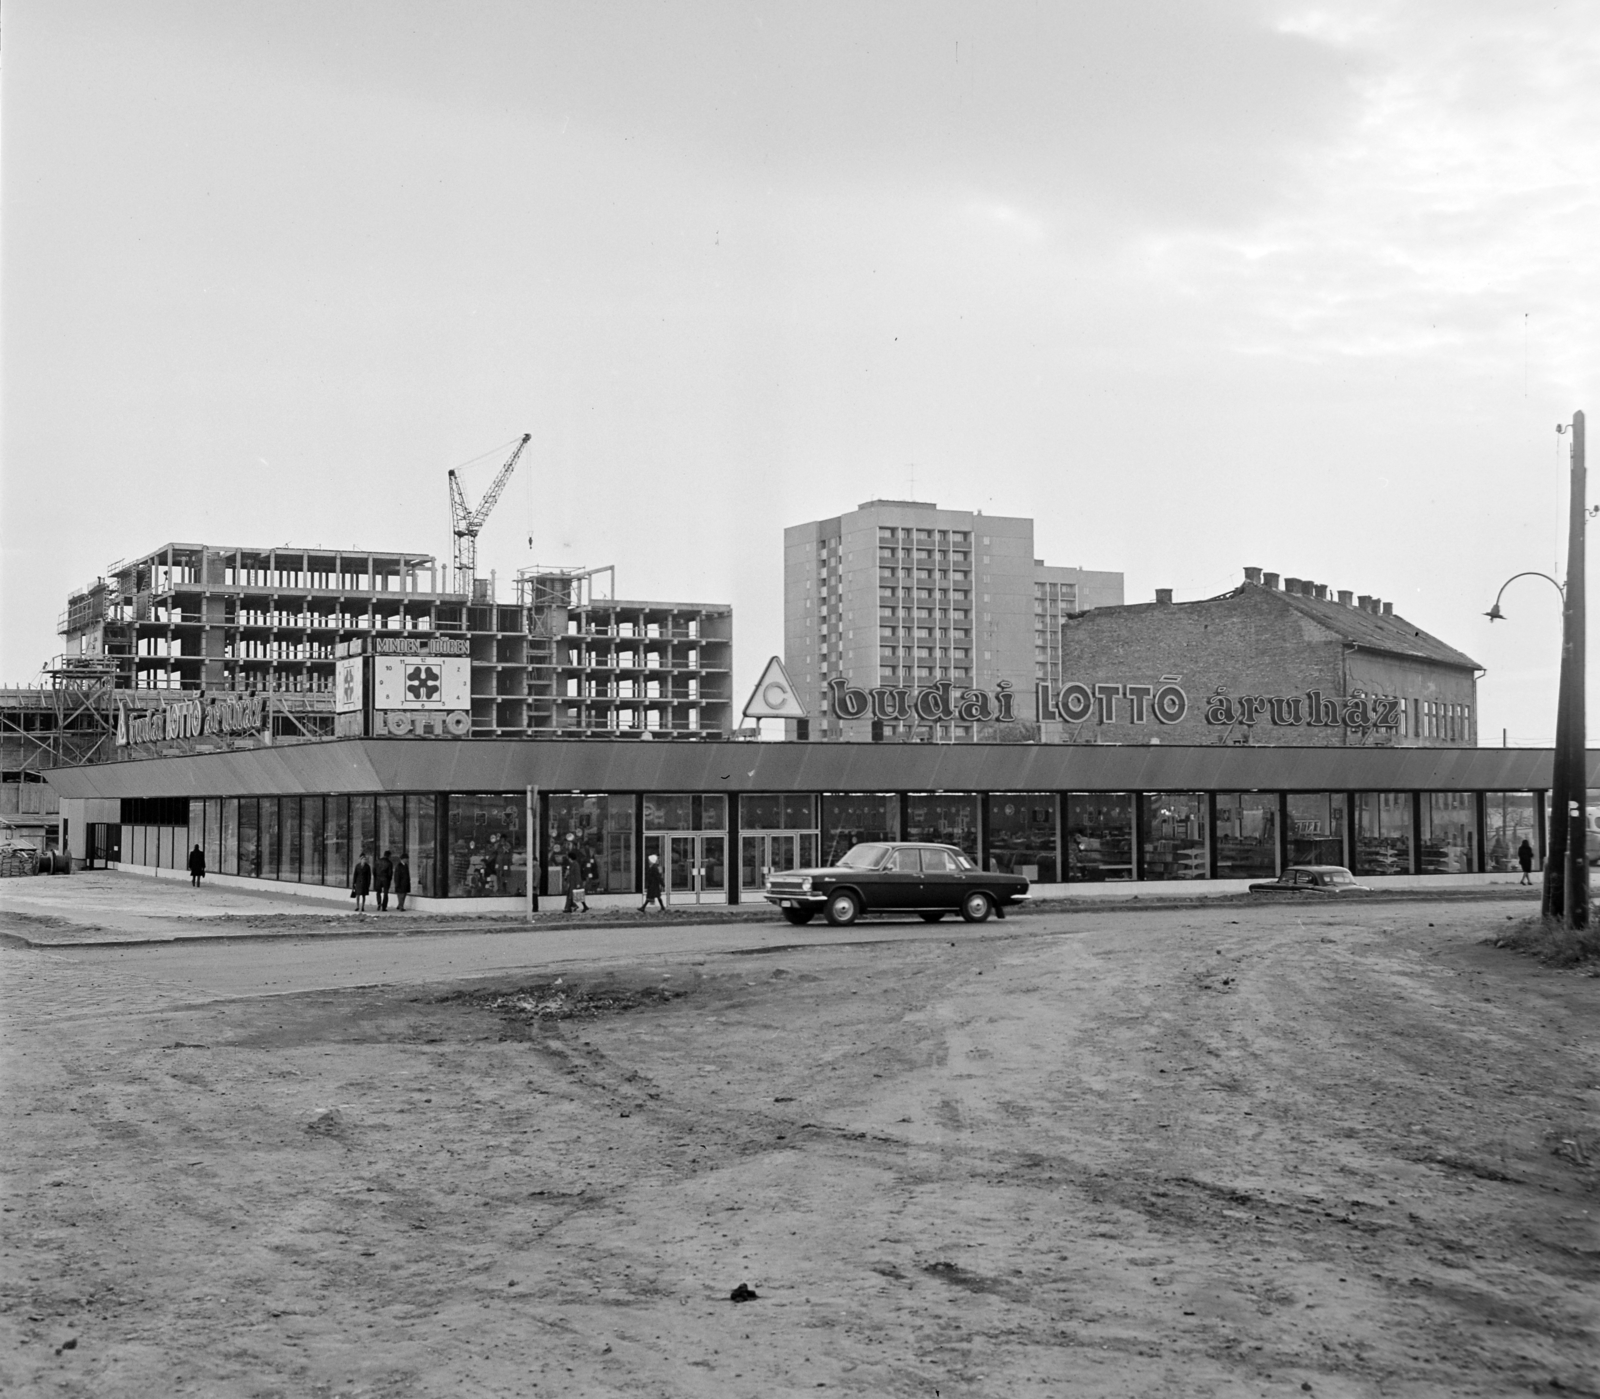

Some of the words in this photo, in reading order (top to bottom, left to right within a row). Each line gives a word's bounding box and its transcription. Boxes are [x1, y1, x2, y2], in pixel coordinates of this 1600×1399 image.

[376, 637, 420, 653] MINDEN
[828, 676, 1016, 723] budai
[1205, 685, 1400, 727] áruház
